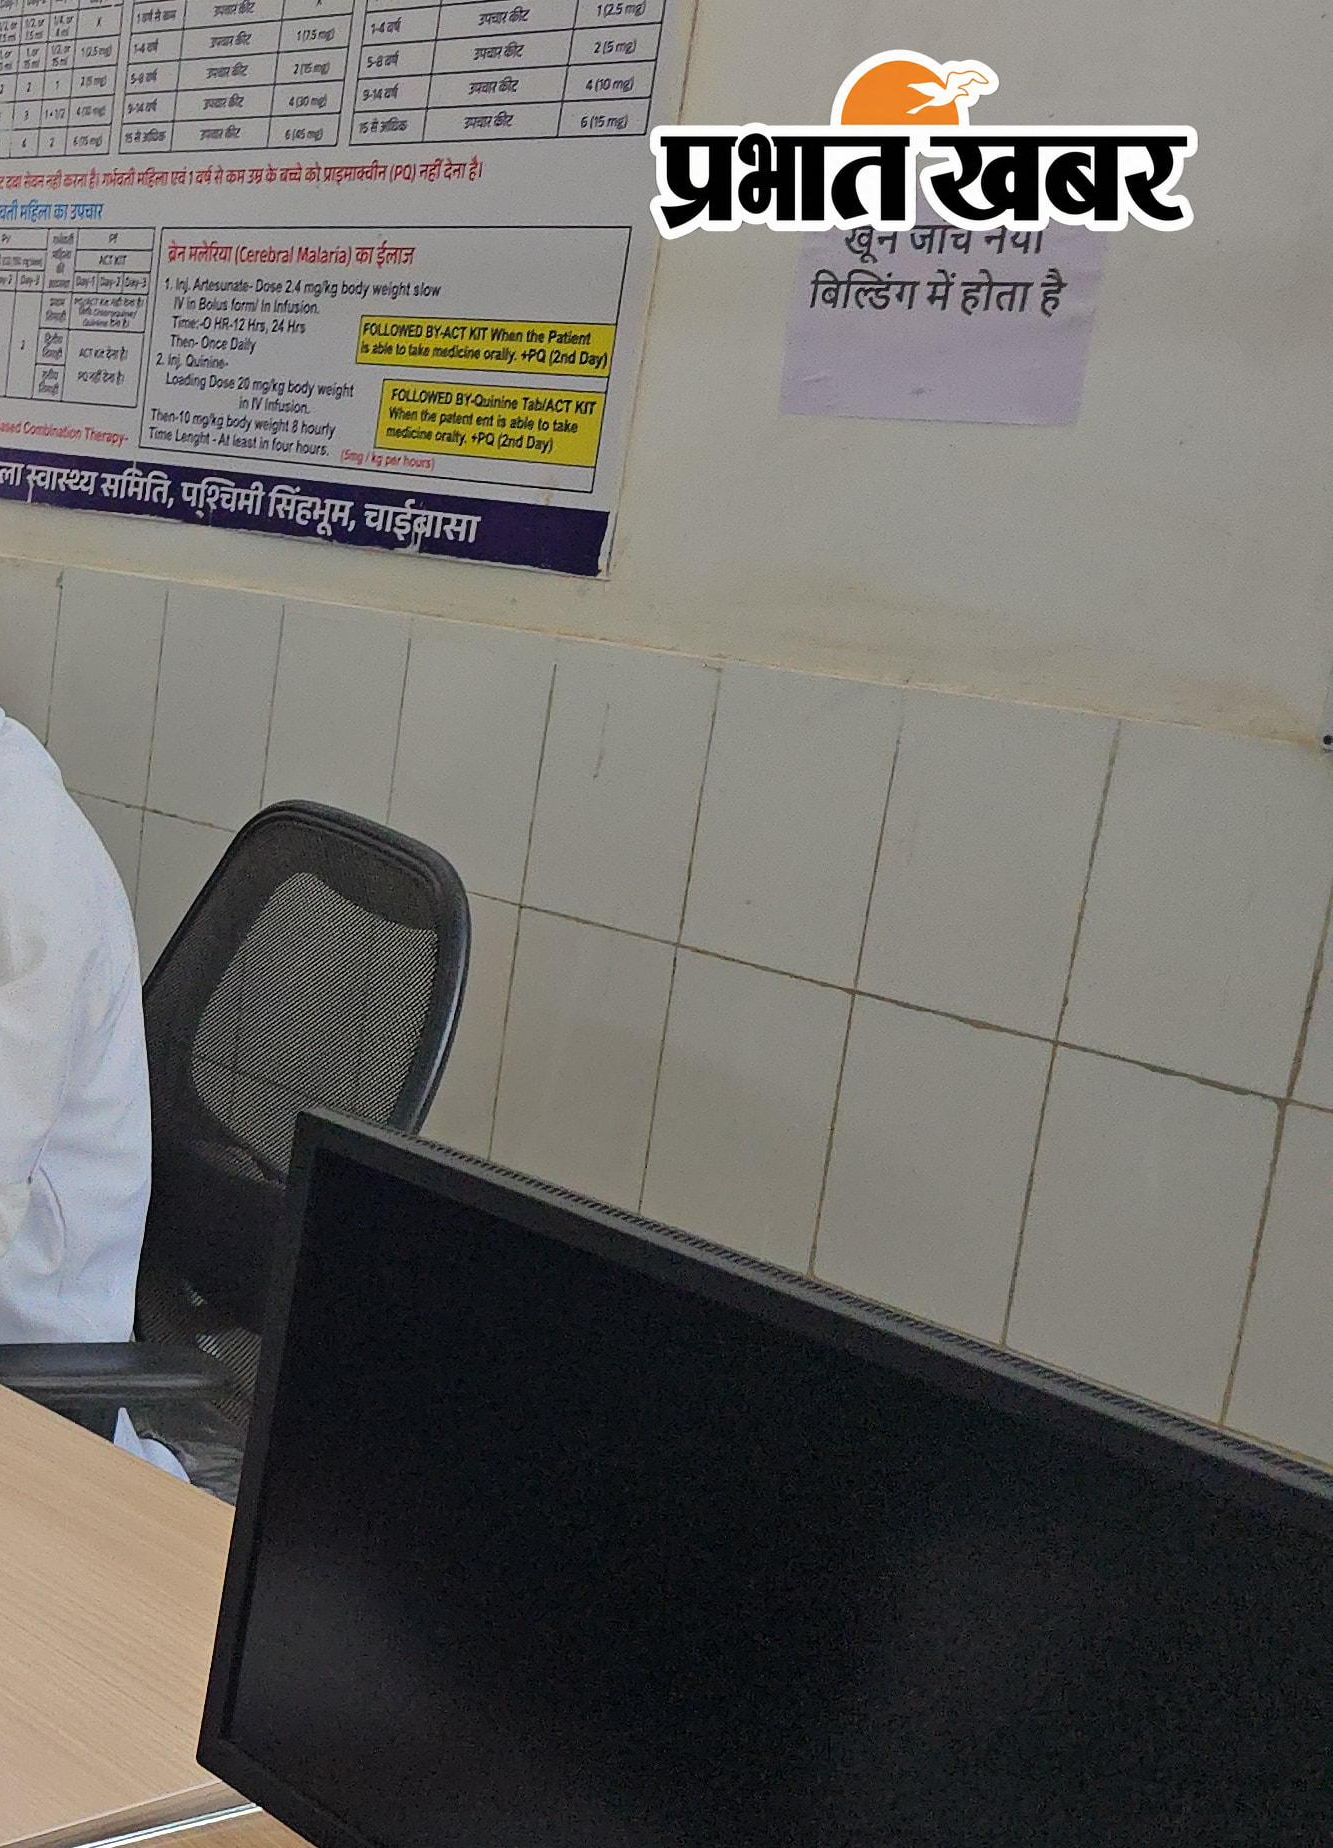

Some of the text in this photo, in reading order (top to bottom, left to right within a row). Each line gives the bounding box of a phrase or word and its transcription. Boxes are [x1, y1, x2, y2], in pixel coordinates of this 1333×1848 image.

[20, 203, 51, 222] महिला
[53, 204, 68, 219] का
[70, 203, 104, 221] उपचार
[167, 239, 416, 269] ब्रेन मलेरिया (Cerebral Malaria) का ईलाज
[175, 278, 191, 293] Inj.
[194, 279, 253, 293] Artesunate-
[255, 280, 282, 293] Dose
[285, 280, 301, 293] 2.4
[303, 281, 337, 298] mg/kg
[341, 281, 369, 298] body
[372, 282, 411, 299] weight
[413, 282, 441, 297] slow
[809, 267, 1068, 317] बिल्डिंग में होता है
[170, 335, 257, 354] Then- Once Daily
[363, 322, 591, 345] FOLLOWED BY-ACT KIT When the Patient
[361, 341, 608, 370] is able to take medicine orally. +PQ (2nd Day)
[166, 374, 355, 399] Loading Dose 20 mg/kg body weight
[391, 388, 597, 415] FOLLOWED BY-Quinine Tab/ACT KIT
[151, 408, 336, 439] Then-10 mg/kg body weight 8 hourly
[389, 406, 578, 433] When the patent ent is able to take
[148, 426, 330, 456] Time Lenght At least in four hours.
[386, 426, 554, 453] medicine orally. +PQ (2nd Day)
[26, 463, 99, 496] स्वास्थ्य
[100, 465, 174, 510] समिति,
[268, 484, 356, 537] सिंहभूम,
[364, 498, 482, 545] चाईबासा
